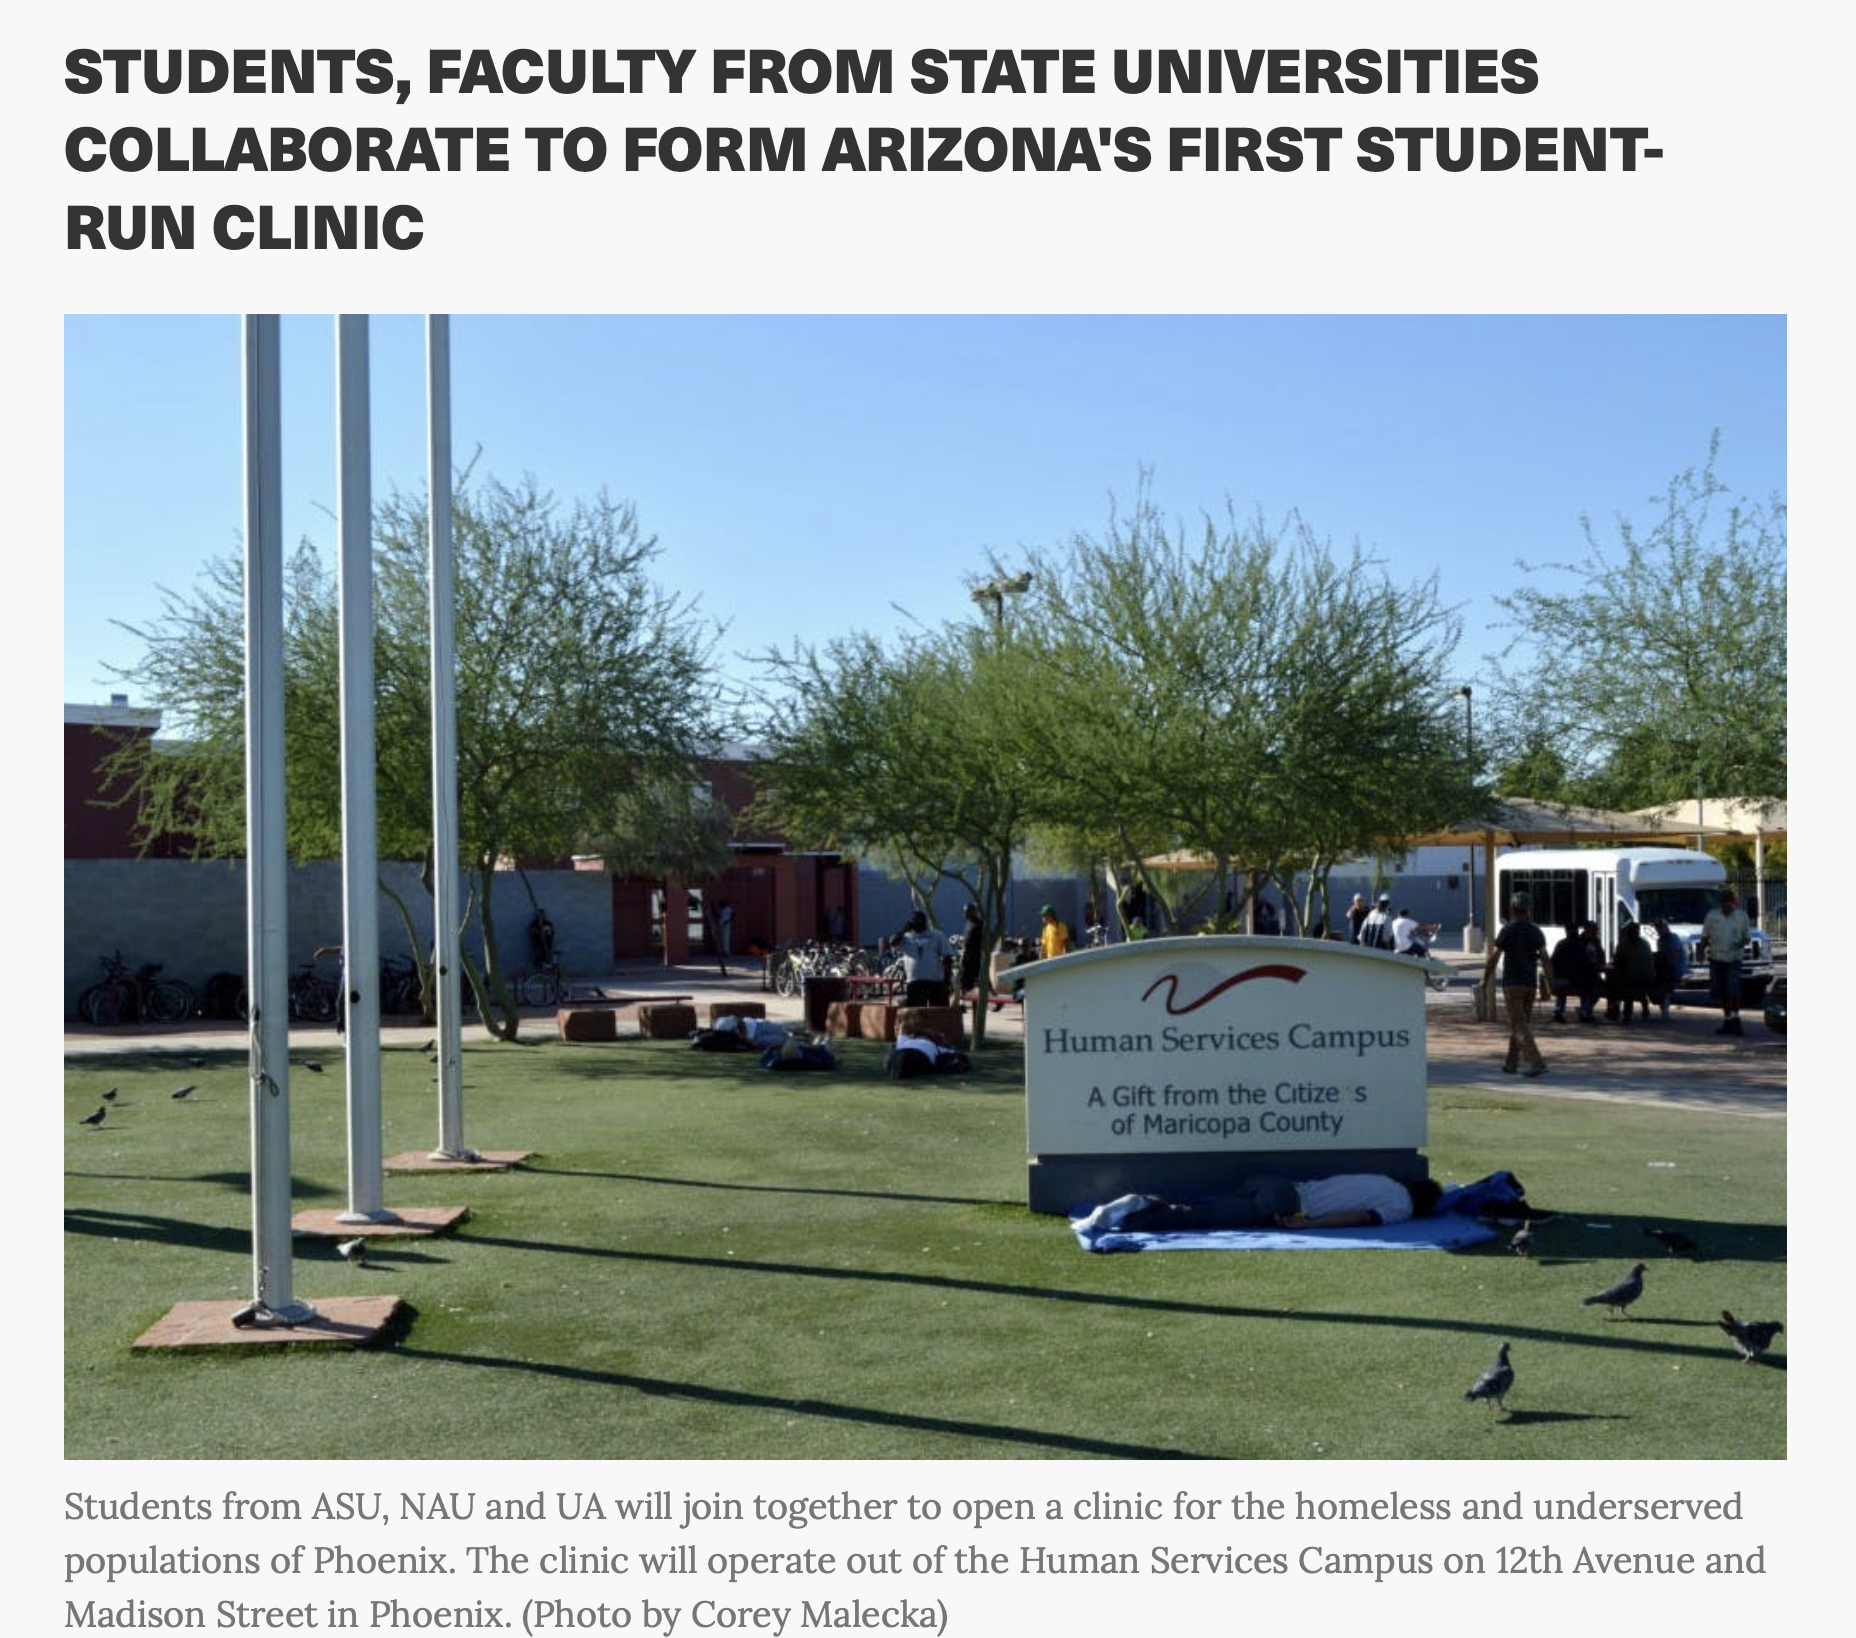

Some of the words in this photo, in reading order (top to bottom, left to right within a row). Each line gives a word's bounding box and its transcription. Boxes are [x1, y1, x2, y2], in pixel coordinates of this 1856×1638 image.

[1043, 1028, 1151, 1053] Human
[1162, 1026, 1280, 1051] Services
[1287, 1024, 1410, 1056] Campus
[1087, 1086, 1105, 1107] A
[1112, 1085, 1156, 1106] Gift
[1163, 1084, 1218, 1106] from
[1228, 1083, 1266, 1105] the
[1275, 1082, 1367, 1104] Citizes
[1111, 1113, 1135, 1135] of
[1144, 1113, 1250, 1138] Maricopa
[1259, 1112, 1343, 1136] County
